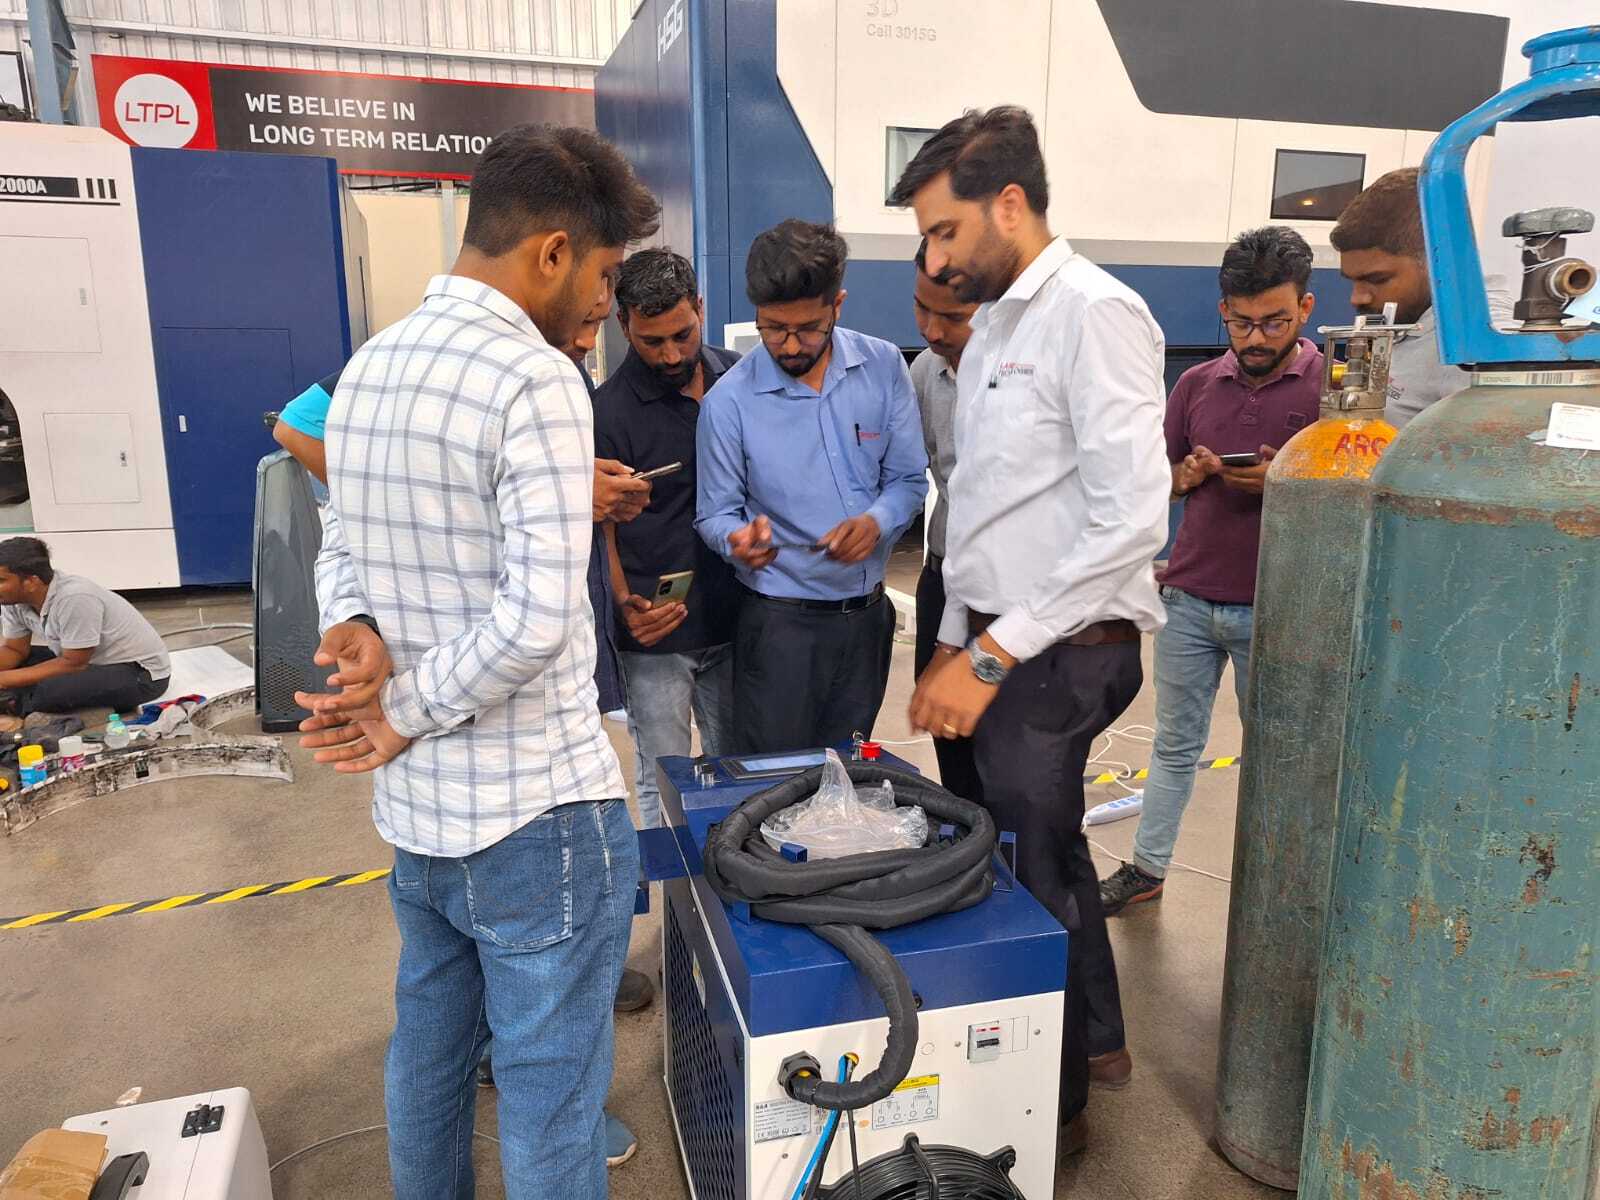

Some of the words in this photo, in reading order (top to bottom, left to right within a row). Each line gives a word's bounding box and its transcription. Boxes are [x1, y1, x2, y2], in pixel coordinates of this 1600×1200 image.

[657, 0, 684, 63] HSG
[125, 102, 190, 125] LTPL
[245, 93, 281, 113] WE
[288, 95, 387, 119] BELIEVE
[393, 102, 416, 120] IN
[249, 124, 315, 145] LONG
[320, 128, 386, 149] TERM
[391, 131, 493, 154] RELATIO
